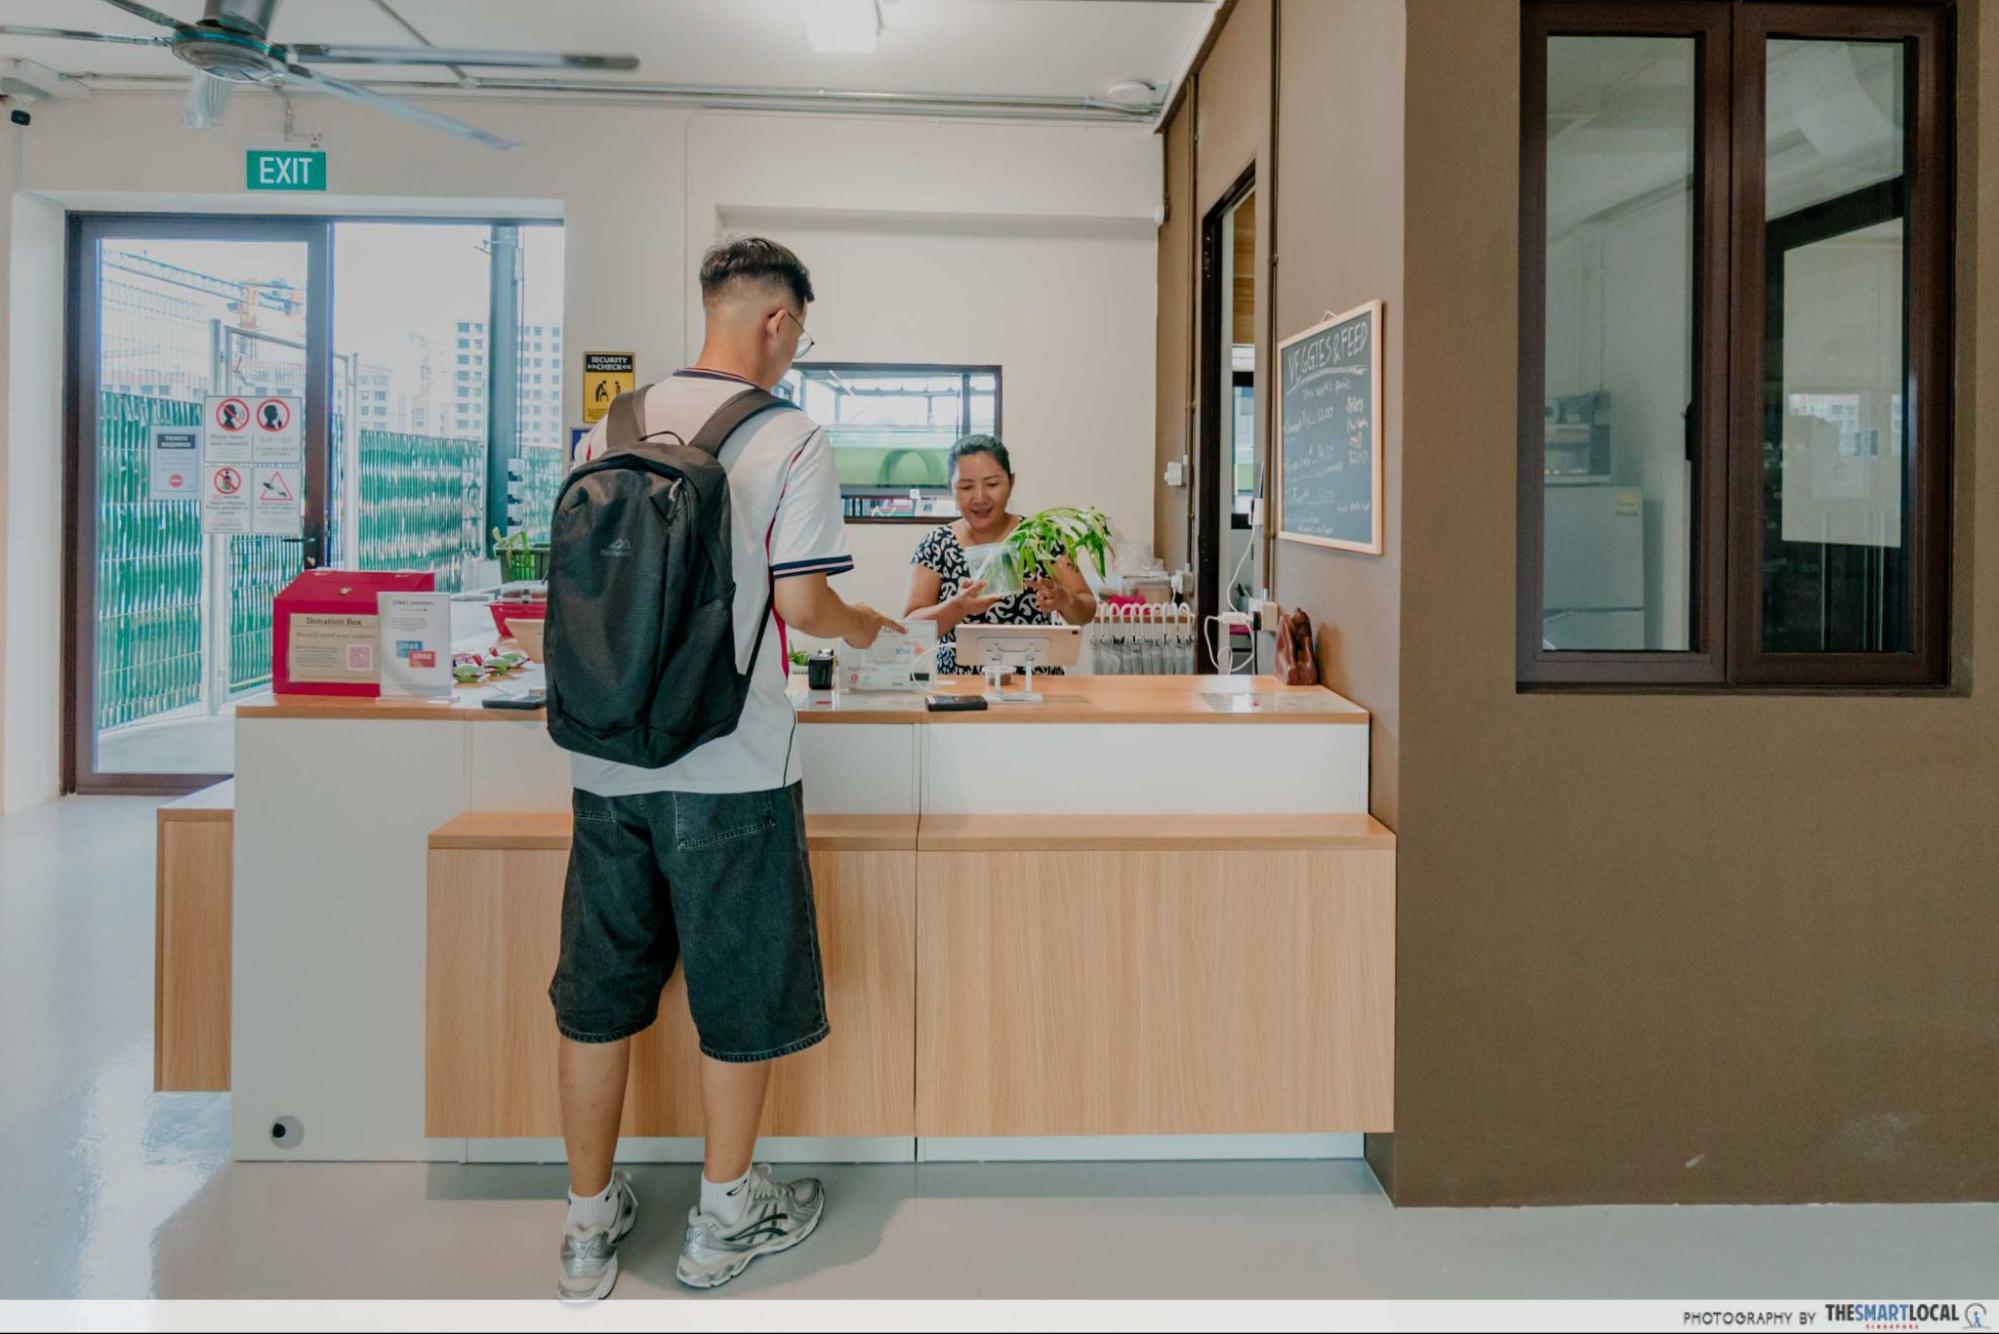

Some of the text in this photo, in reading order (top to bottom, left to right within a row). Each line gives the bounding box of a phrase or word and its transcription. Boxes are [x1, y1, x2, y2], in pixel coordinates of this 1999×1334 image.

[259, 156, 313, 184] EXIT
[1341, 321, 1368, 360] FEED
[306, 616, 362, 626] Donation Box
